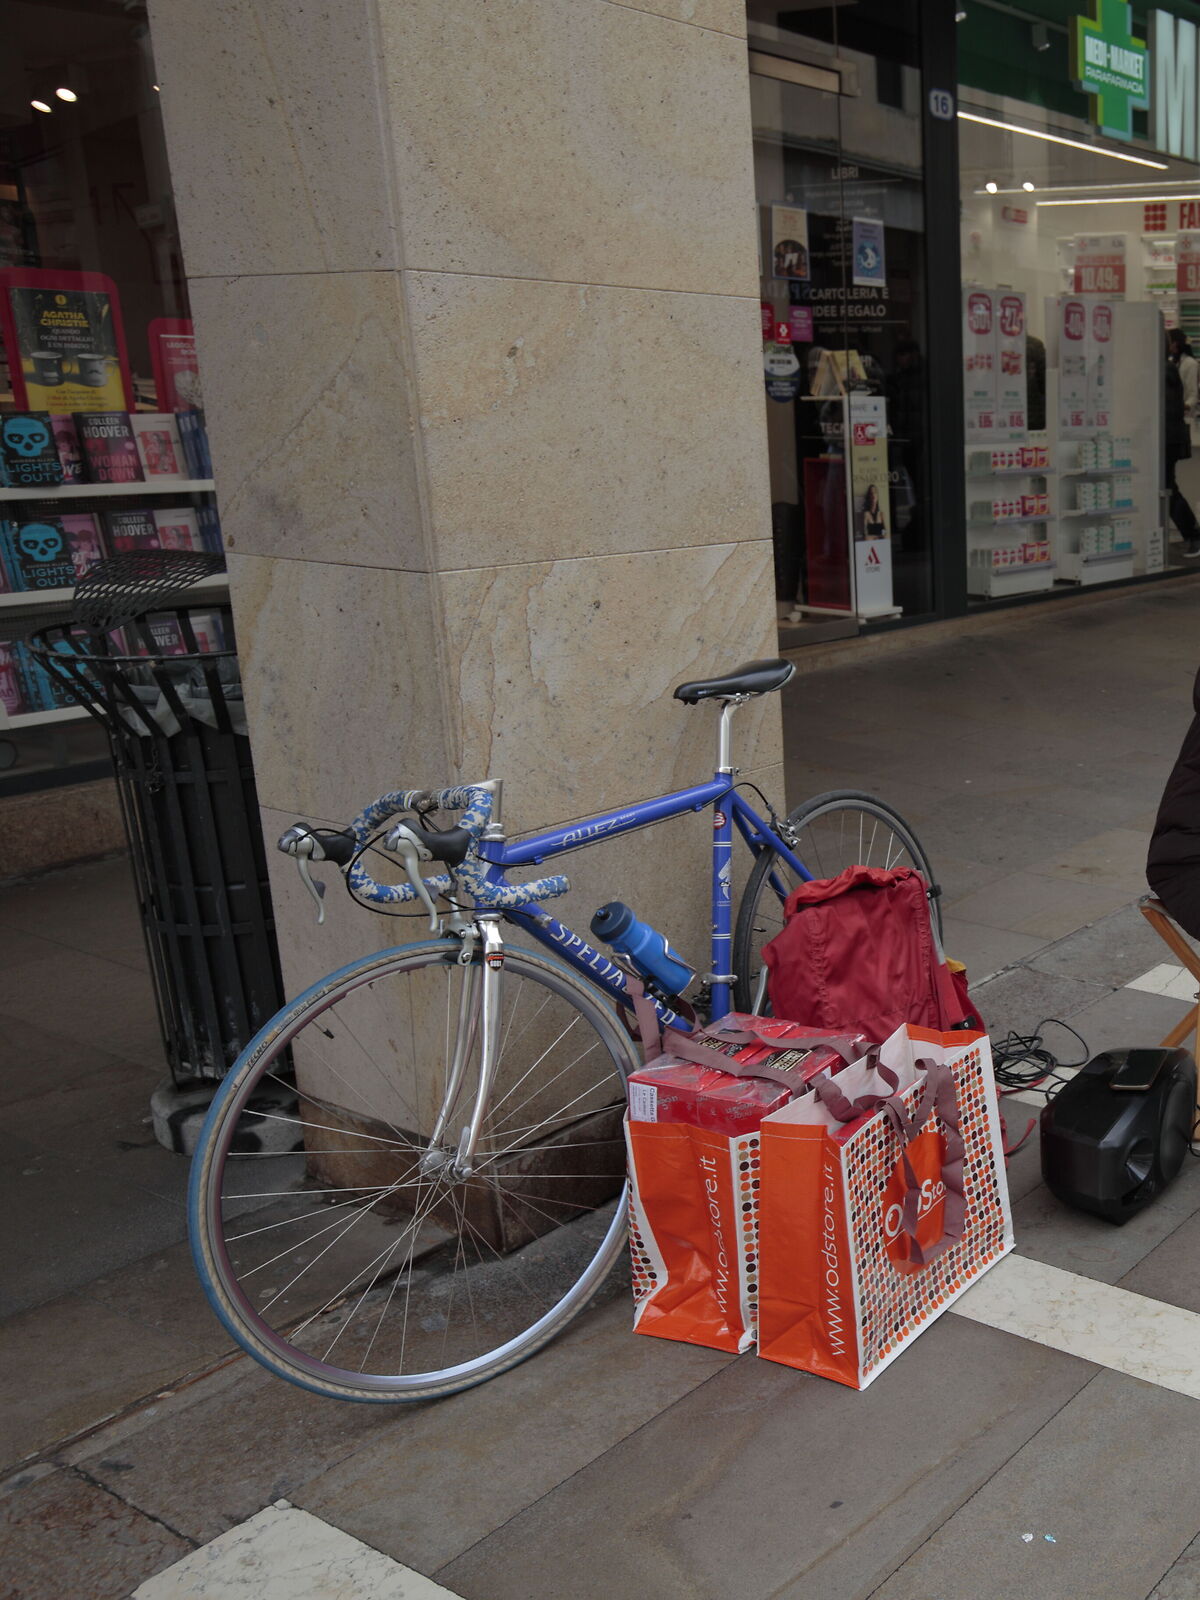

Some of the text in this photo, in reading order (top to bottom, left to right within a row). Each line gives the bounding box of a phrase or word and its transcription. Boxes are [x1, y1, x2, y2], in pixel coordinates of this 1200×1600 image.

[1084, 35, 1144, 80] MEDI-MARKET
[1084, 66, 1145, 95] PARAFARMACIA
[934, 94, 949, 115] 16
[831, 166, 859, 179] LIBRI
[809, 287, 878, 300] CARTOLERIA
[881, 286, 889, 299] E
[41, 310, 86, 320] AGATHA
[813, 304, 838, 317] IDEE
[40, 319, 90, 329] CHRISTIE
[88, 416, 120, 425] COLLEEN
[83, 425, 129, 438] HOOVER
[7, 460, 61, 473] LIGHTS
[90, 454, 138, 468] WOMAN
[20, 472, 53, 484] OUT
[97, 467, 136, 481] DOWN
[112, 523, 154, 537] HOOVER
[22, 565, 76, 578] LIGHTS
[36, 576, 66, 587] OUT
[819, 1163, 847, 1357] www.odstore.it
